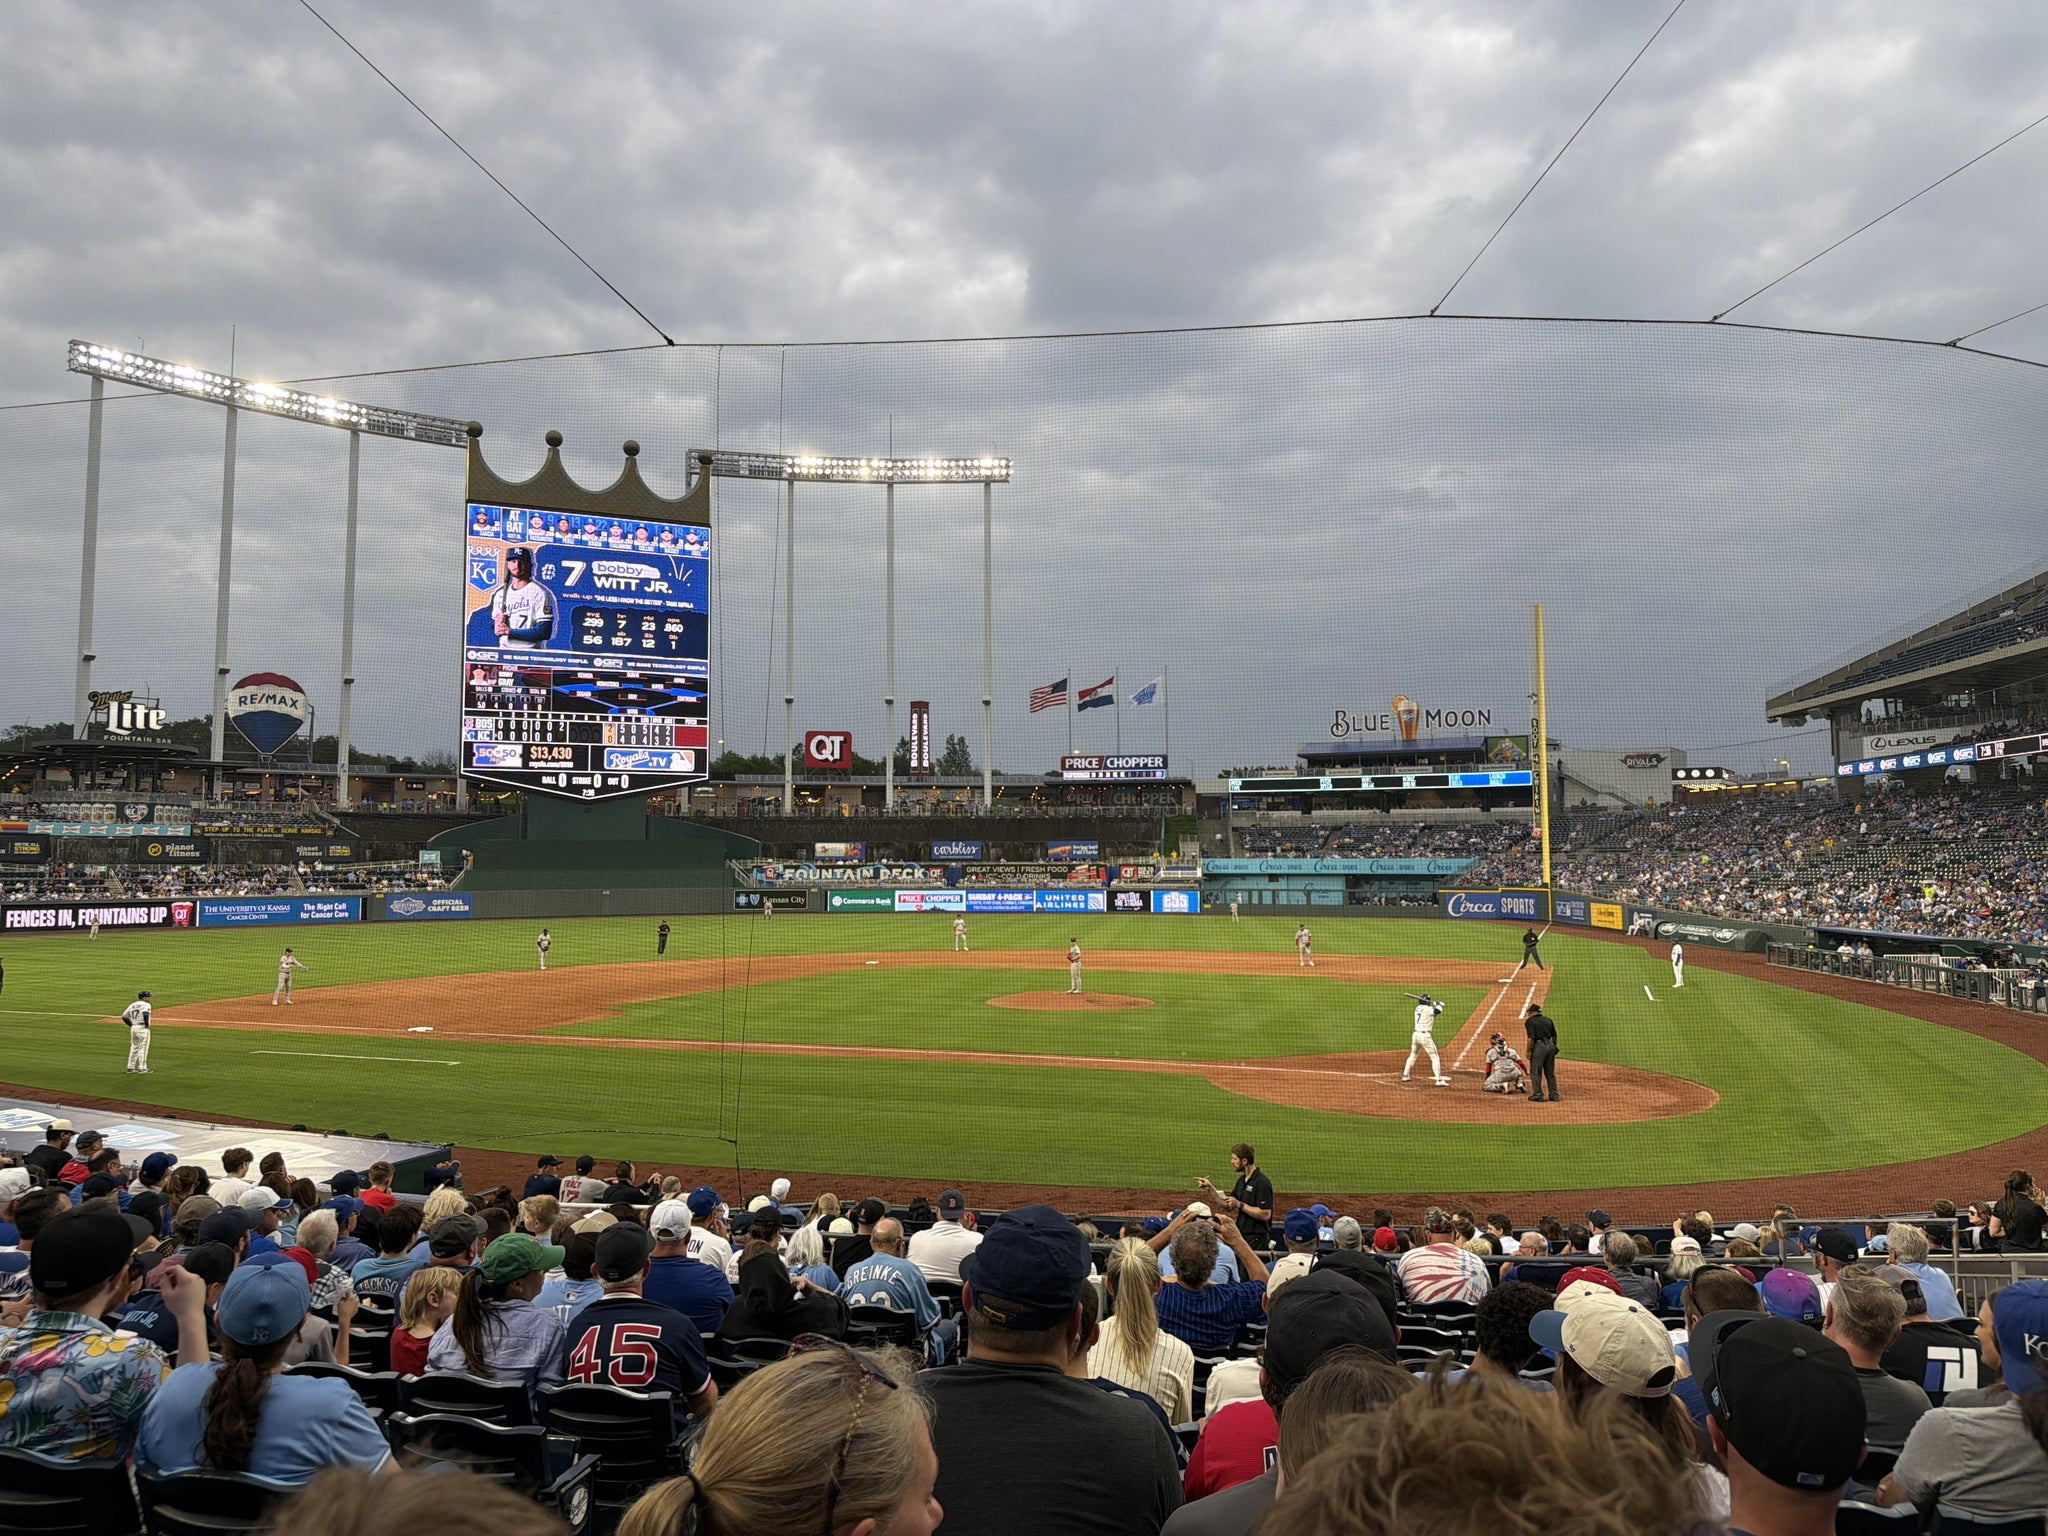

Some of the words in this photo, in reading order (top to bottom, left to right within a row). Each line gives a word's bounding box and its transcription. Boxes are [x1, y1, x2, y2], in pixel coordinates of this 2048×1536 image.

[510, 510, 520, 520] AT
[506, 522, 524, 532] BAT
[571, 516, 580, 528] 13
[596, 520, 607, 530] 22
[623, 522, 632, 534] 14
[674, 528, 684, 538] 19
[697, 529, 708, 540] 28
[471, 562, 496, 584] KC
[542, 564, 556, 580] #
[562, 560, 586, 586] 7
[598, 563, 643, 576] bobby
[594, 576, 640, 590] WITT
[644, 580, 672, 594] JR.
[519, 615, 528, 628] 7
[582, 618, 604, 627] .299
[618, 620, 626, 628] 7
[642, 622, 656, 631] 23
[664, 624, 684, 632] .860
[583, 636, 602, 644] 56
[611, 638, 632, 646] 187
[642, 640, 655, 648] 12
[671, 641, 676, 650] 1
[89, 691, 132, 708] Miller
[239, 694, 298, 710] RE/MAX
[105, 702, 166, 735] Lite
[476, 719, 492, 728] BOS
[1330, 709, 1390, 738] BLUE
[1425, 708, 1492, 728] MOON
[104, 734, 152, 744] FOUNTAIN
[156, 736, 172, 744] BAR
[478, 730, 490, 740] KC
[1888, 736, 1936, 746] LEXUS
[479, 748, 492, 757] 50
[502, 750, 516, 758] 50
[530, 746, 572, 760] $13,430
[810, 735, 844, 762] QT
[610, 750, 650, 768] Royals
[648, 757, 667, 766] .TV
[1065, 758, 1099, 768] PRICE
[1106, 756, 1164, 768] CHOPPER
[1626, 758, 1658, 766] RIVALS
[542, 776, 556, 784] BALL
[558, 774, 566, 788] 0
[572, 776, 592, 785] STRIKE
[594, 774, 602, 788] 0
[608, 777, 619, 786] OUT
[621, 774, 629, 788] 0
[166, 843, 194, 852] planet
[934, 844, 979, 857] carbliss
[1206, 860, 1230, 873] Circa
[1260, 860, 1282, 873] Circa
[1314, 859, 1338, 872] Circa
[1370, 859, 1394, 872] Circa
[1426, 859, 1452, 872] Circa
[784, 868, 874, 880] FOUNTAIN
[880, 868, 926, 880] DECK
[1122, 868, 1134, 877] QT
[790, 896, 806, 905] City
[1448, 893, 1496, 917] Circa
[1501, 898, 1536, 916] SPORTS
[220, 904, 258, 912] UNIVERSITY
[304, 903, 316, 911] The
[316, 902, 332, 912] Right
[333, 902, 346, 910] Call
[6, 909, 56, 928] FENCES
[58, 908, 76, 928] IN,
[150, 906, 168, 923] UP
[174, 909, 188, 920] QT
[132, 1010, 140, 1019] 17
[1417, 1013, 1422, 1024] 7
[564, 1180, 582, 1188] TRACY
[561, 1190, 580, 1203] 17
[948, 1198, 958, 1208] B
[846, 1264, 902, 1290] GREINKE
[356, 1278, 398, 1294] JACKSO
[252, 1328, 270, 1340] KC
[2024, 1333, 2048, 1361] KC
[568, 1323, 662, 1386] 45
